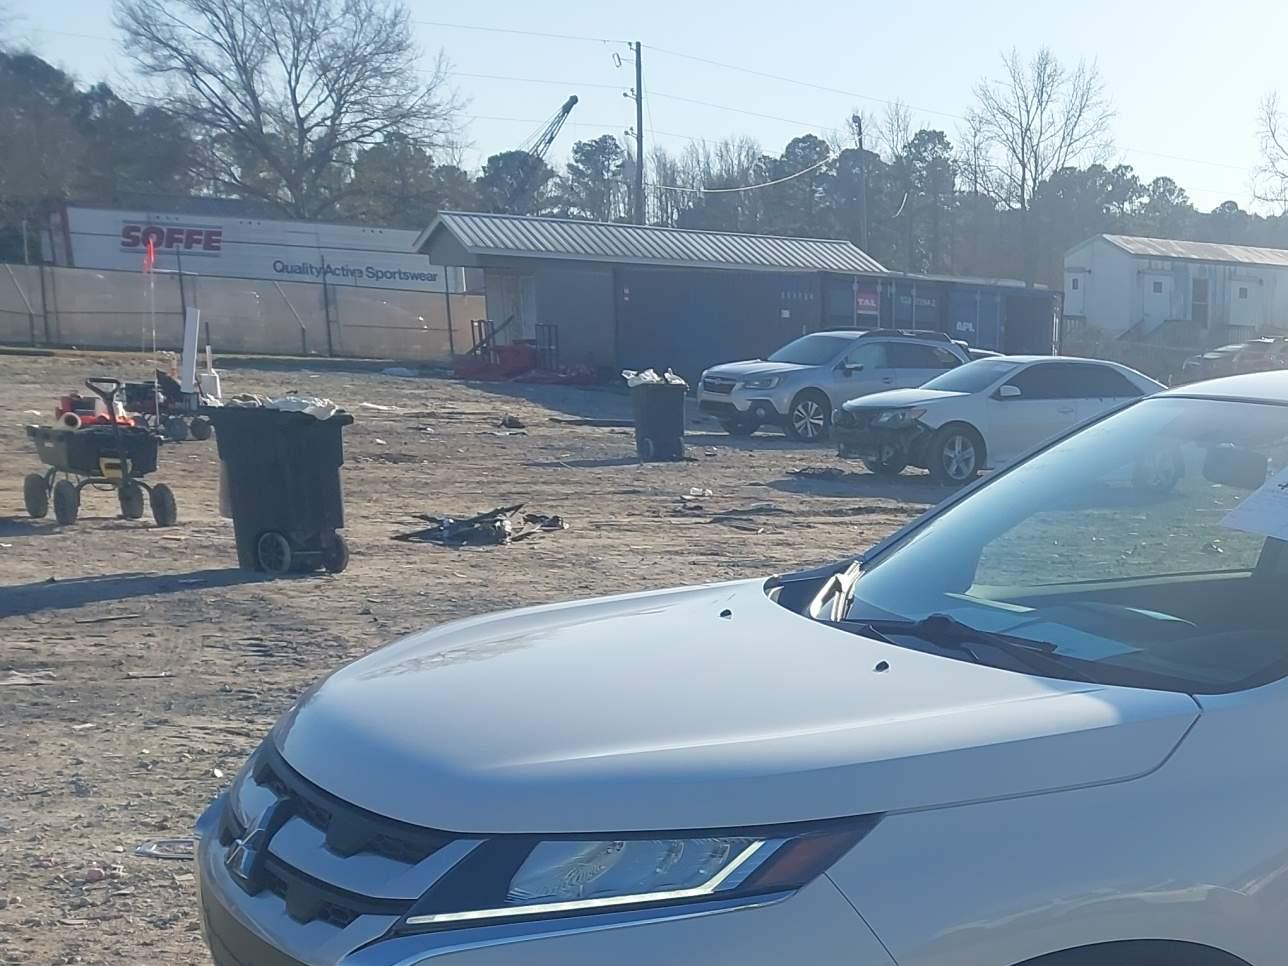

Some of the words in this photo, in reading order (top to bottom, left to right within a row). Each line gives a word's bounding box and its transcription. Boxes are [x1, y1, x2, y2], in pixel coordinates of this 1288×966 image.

[121, 226, 222, 251] SOFFE
[273, 260, 322, 278] Quality
[323, 263, 363, 279] Active
[365, 266, 438, 282] Sportswear
